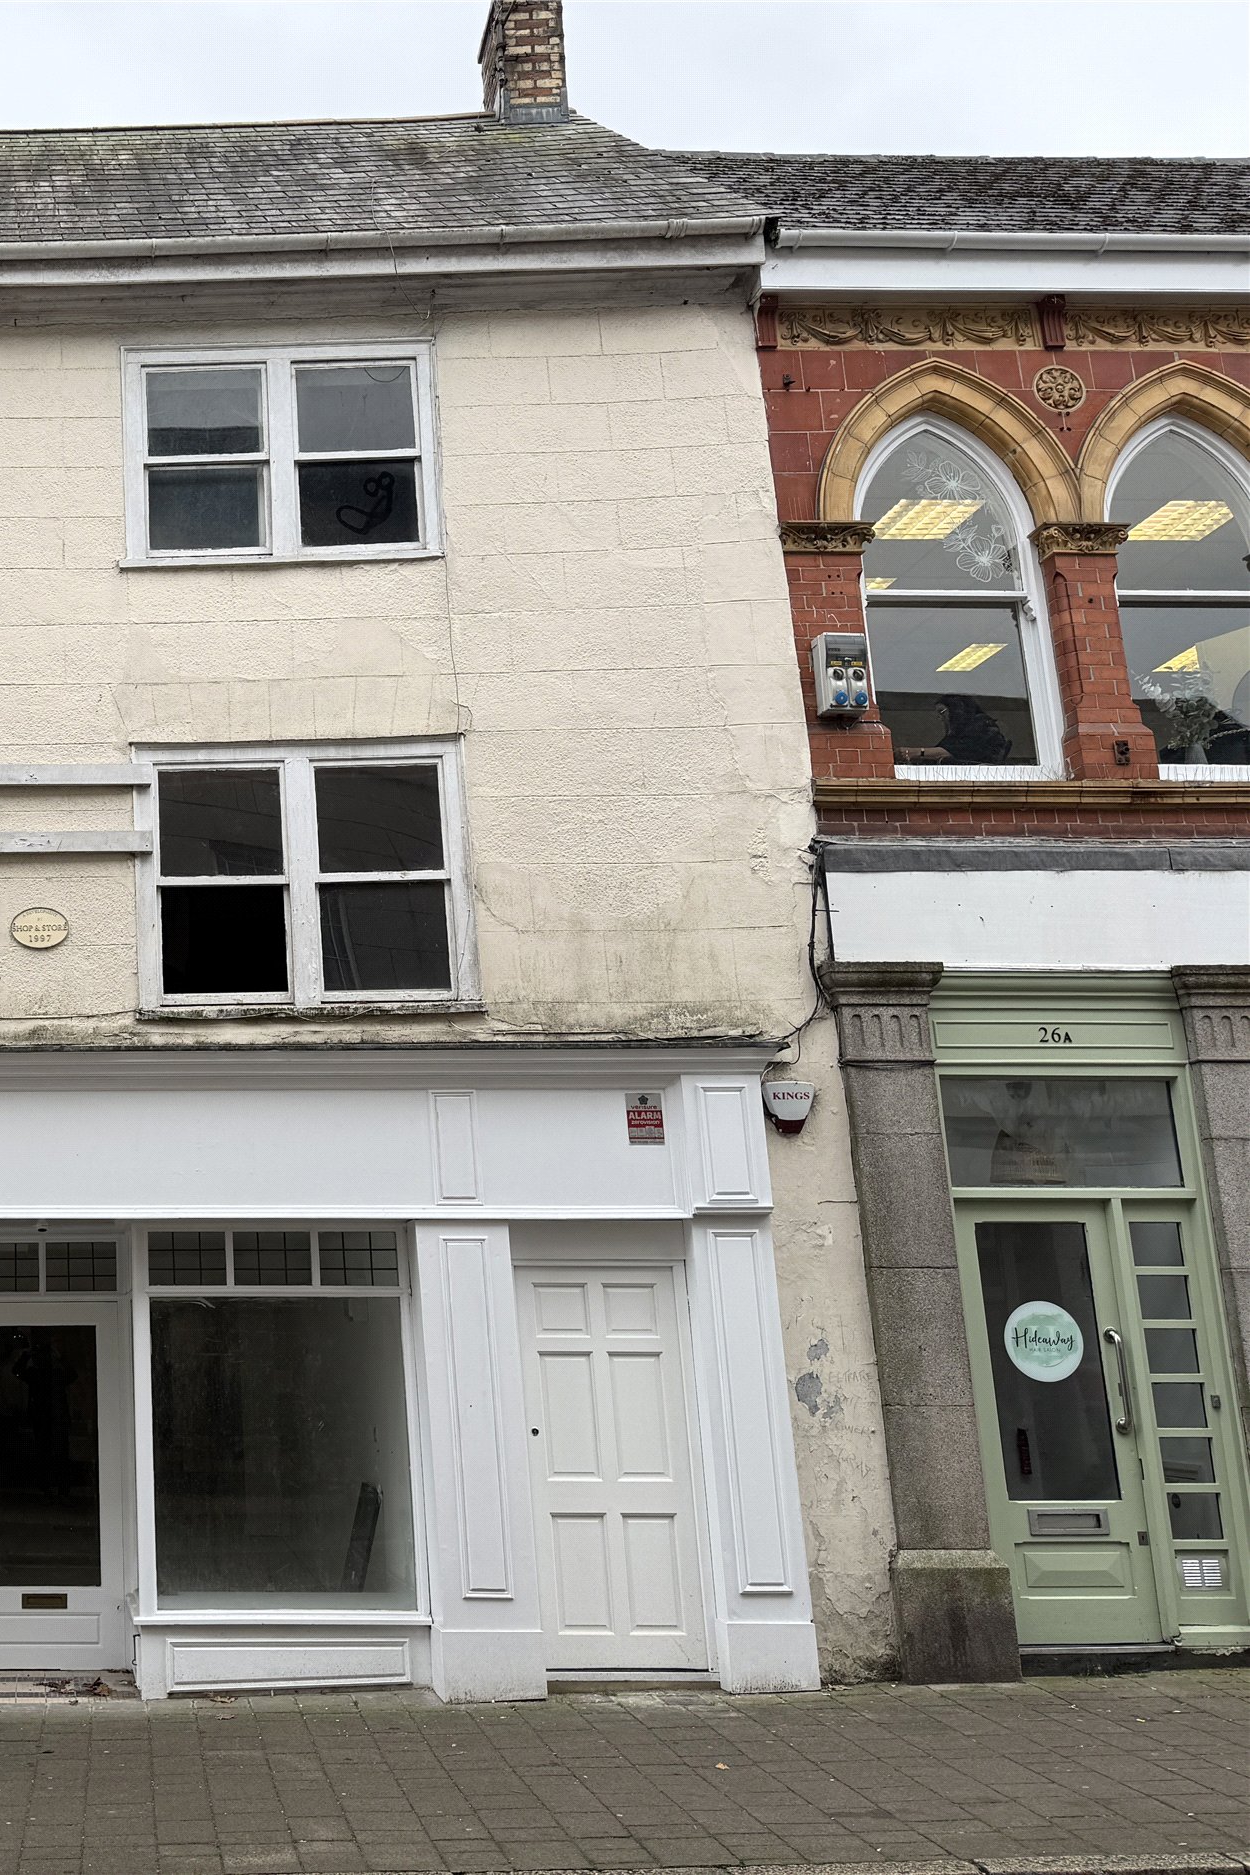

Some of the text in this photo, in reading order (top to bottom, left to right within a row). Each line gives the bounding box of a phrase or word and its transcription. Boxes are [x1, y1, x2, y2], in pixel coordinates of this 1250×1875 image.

[12, 924, 34, 932] SHOP
[29, 934, 51, 943] 1997
[1038, 1027, 1072, 1043] 26A
[773, 1091, 810, 1100] KINGS
